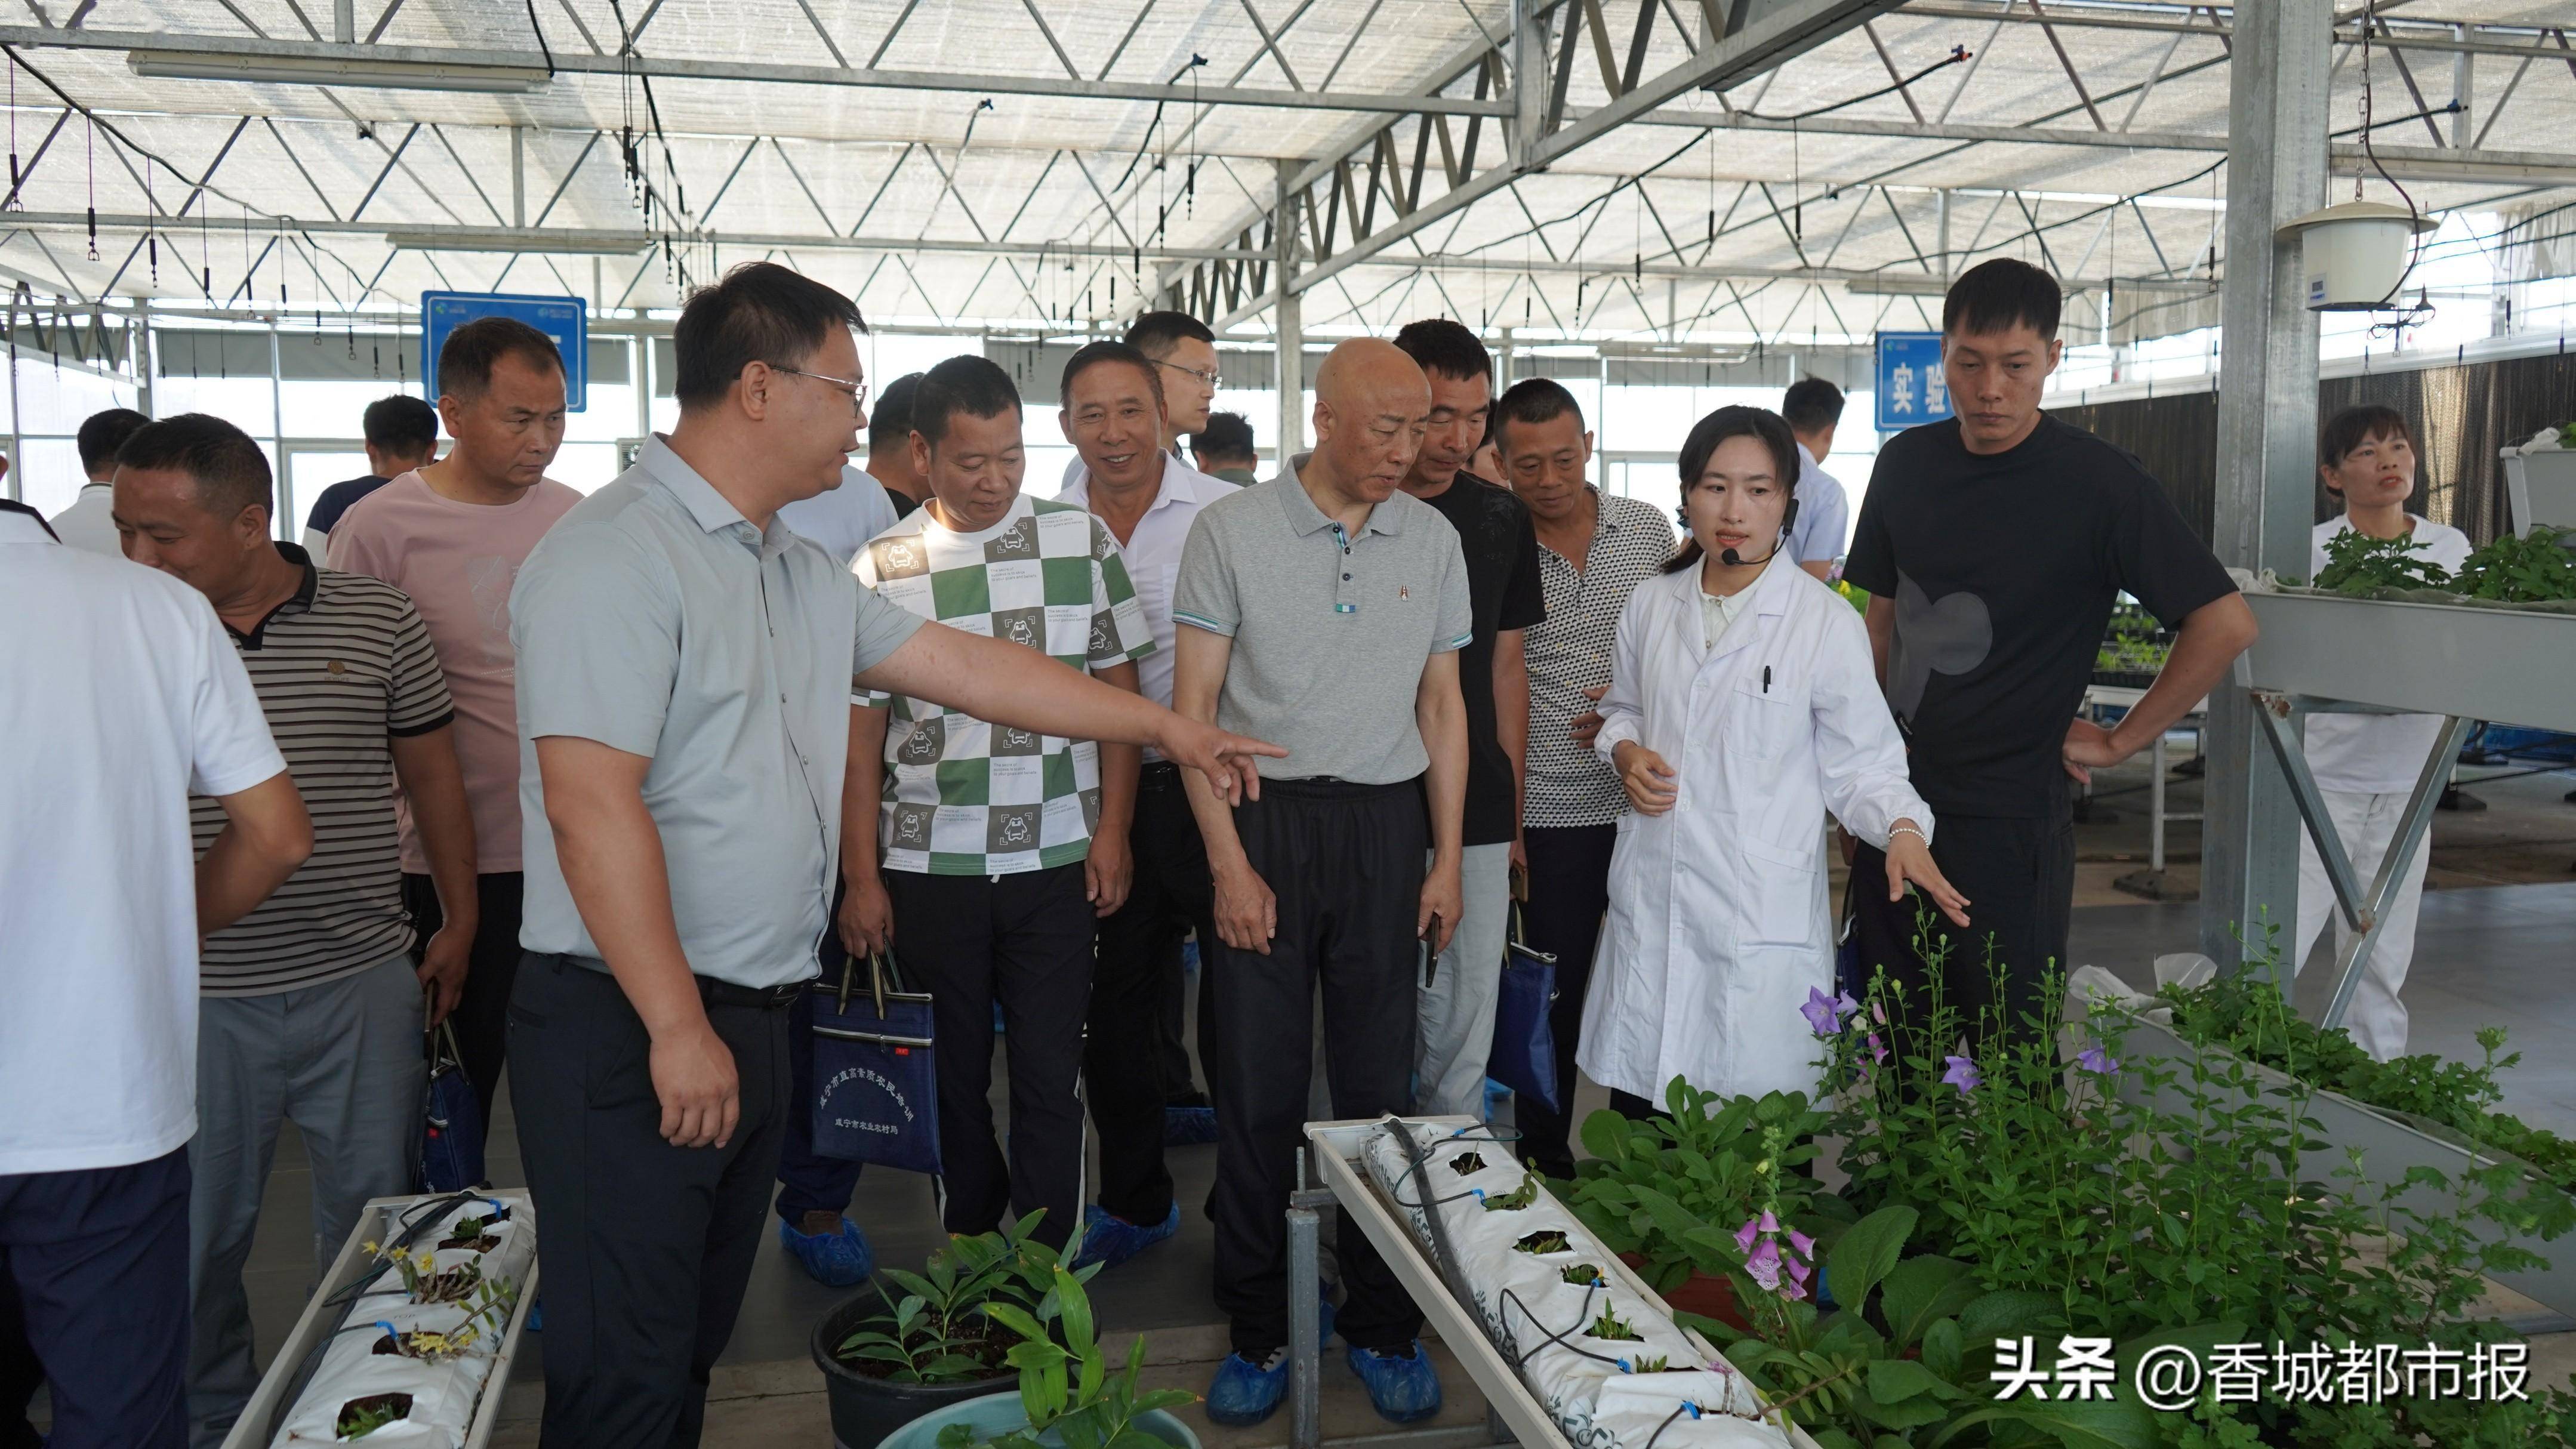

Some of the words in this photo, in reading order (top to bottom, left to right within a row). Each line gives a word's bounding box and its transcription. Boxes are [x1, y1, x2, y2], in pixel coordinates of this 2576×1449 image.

[1893, 362, 1946, 414] 实验
[835, 1118, 898, 1134] 咸宁市农业农村局
